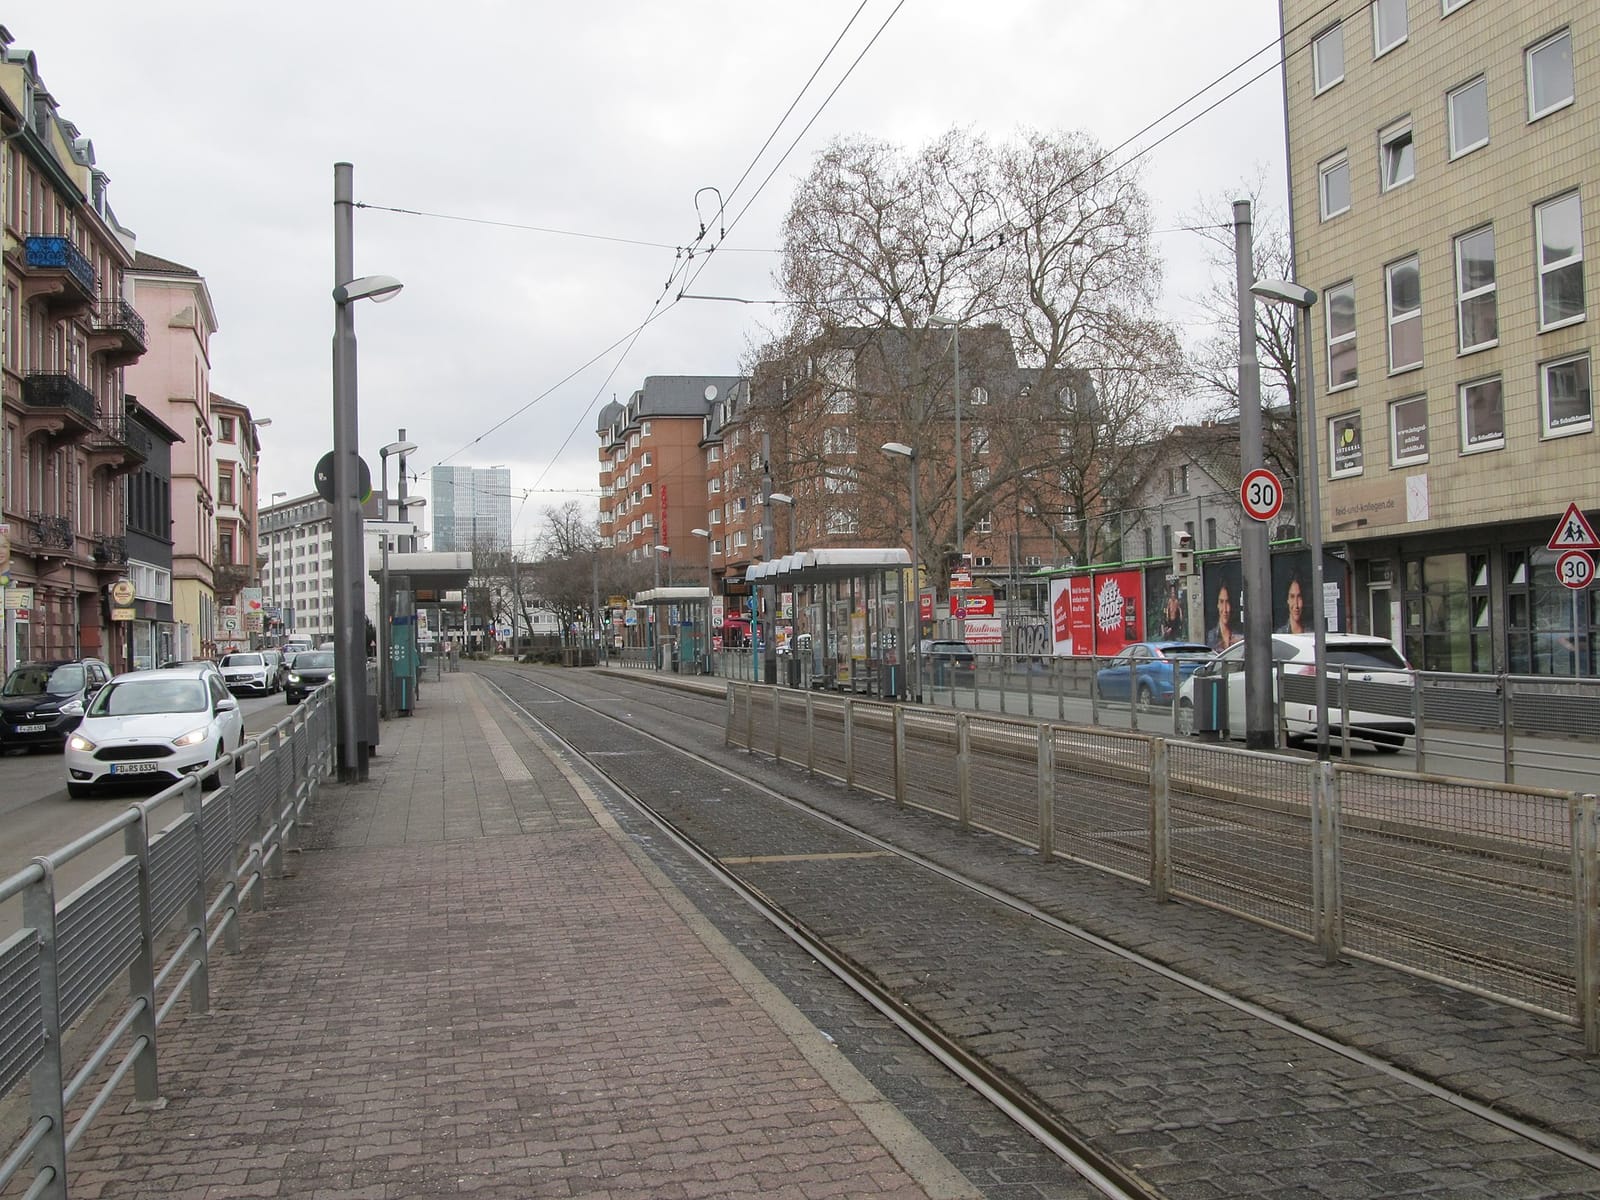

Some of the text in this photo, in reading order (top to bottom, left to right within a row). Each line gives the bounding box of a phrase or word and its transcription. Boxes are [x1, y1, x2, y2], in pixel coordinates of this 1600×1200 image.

[1336, 444, 1360, 454] INTEGRAL
[1250, 483, 1274, 506] 30
[1564, 561, 1586, 578] 30
